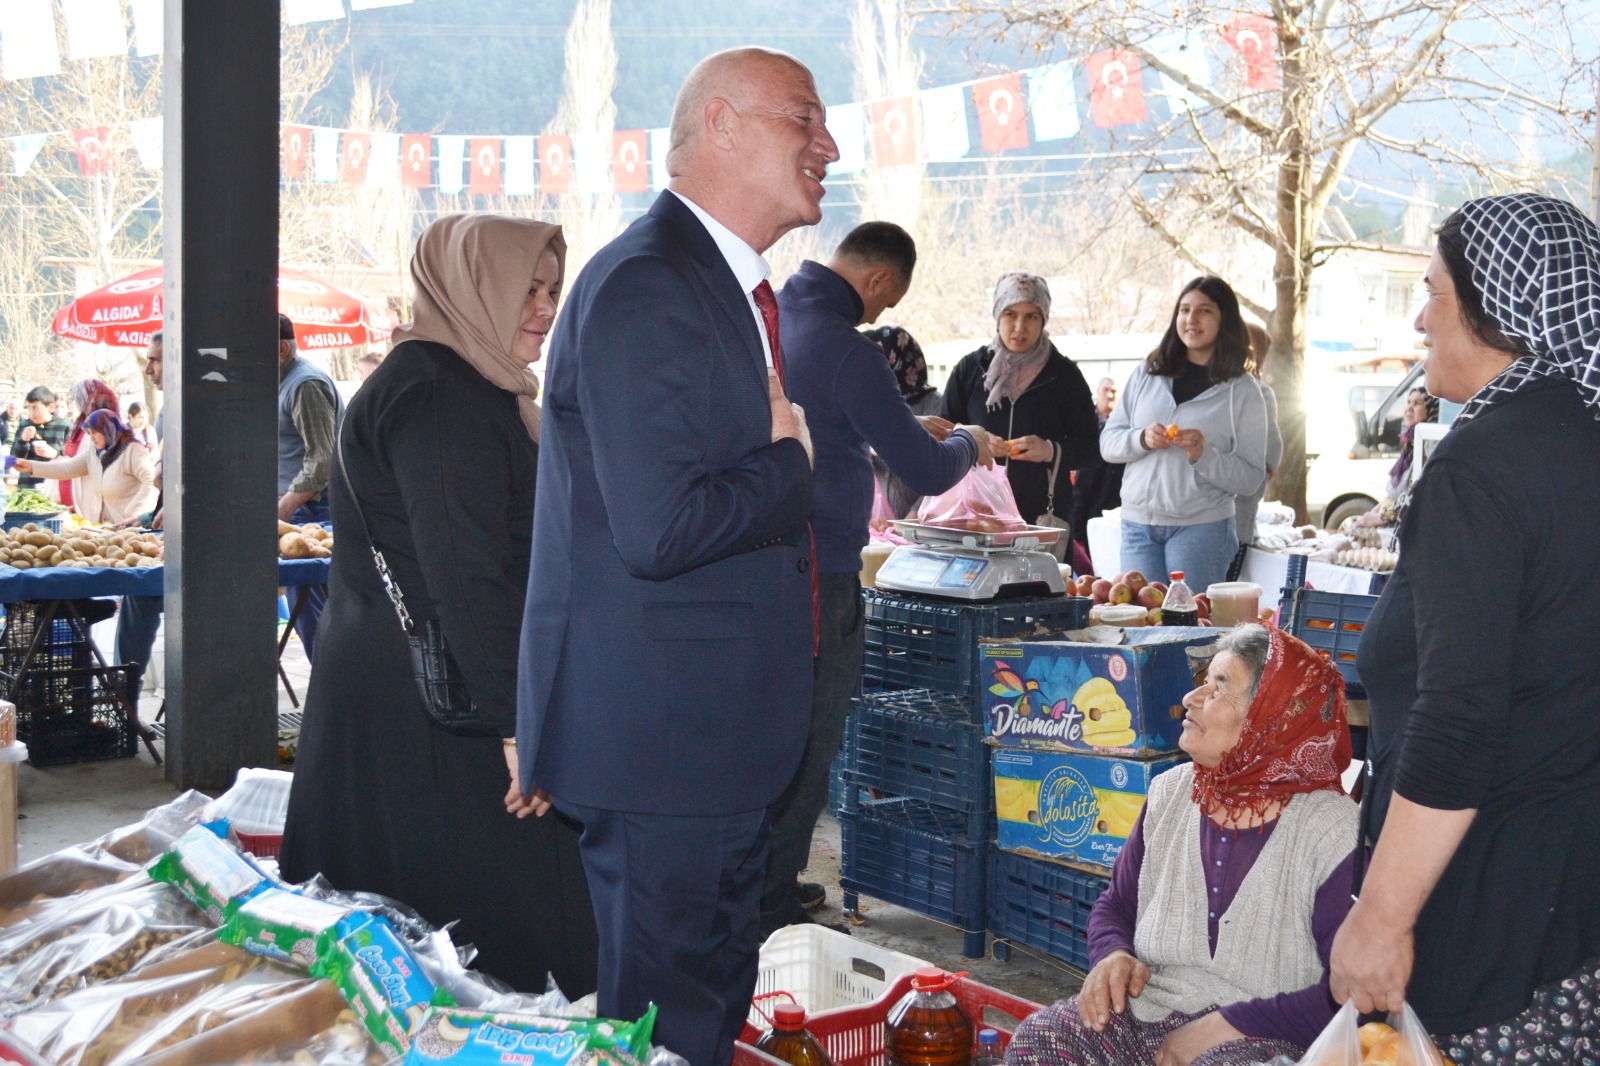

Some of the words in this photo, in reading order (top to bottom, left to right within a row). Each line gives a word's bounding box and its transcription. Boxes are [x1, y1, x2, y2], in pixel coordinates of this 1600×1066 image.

[992, 703, 1083, 741] Diamante
[355, 945, 392, 977] Coco
[476, 1022, 522, 1048] Star
[522, 1030, 575, 1056] Coco
